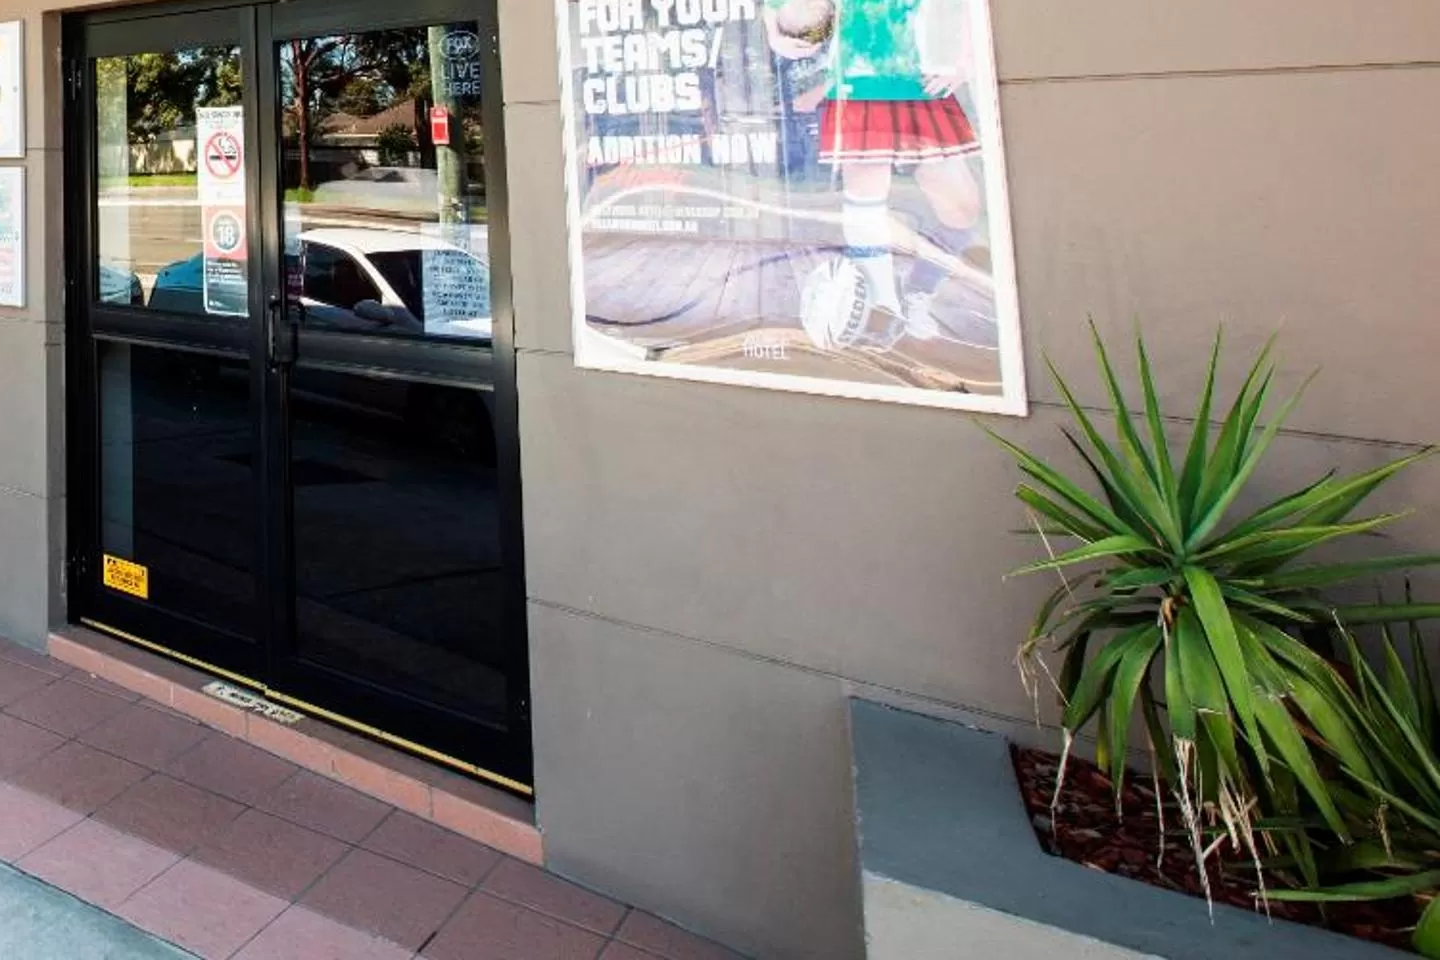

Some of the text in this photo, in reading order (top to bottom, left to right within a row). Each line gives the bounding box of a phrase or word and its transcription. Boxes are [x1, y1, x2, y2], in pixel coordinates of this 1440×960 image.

[441, 62, 480, 80] LIVE
[440, 81, 480, 96] HERE
[582, 72, 703, 116] CLUBS
